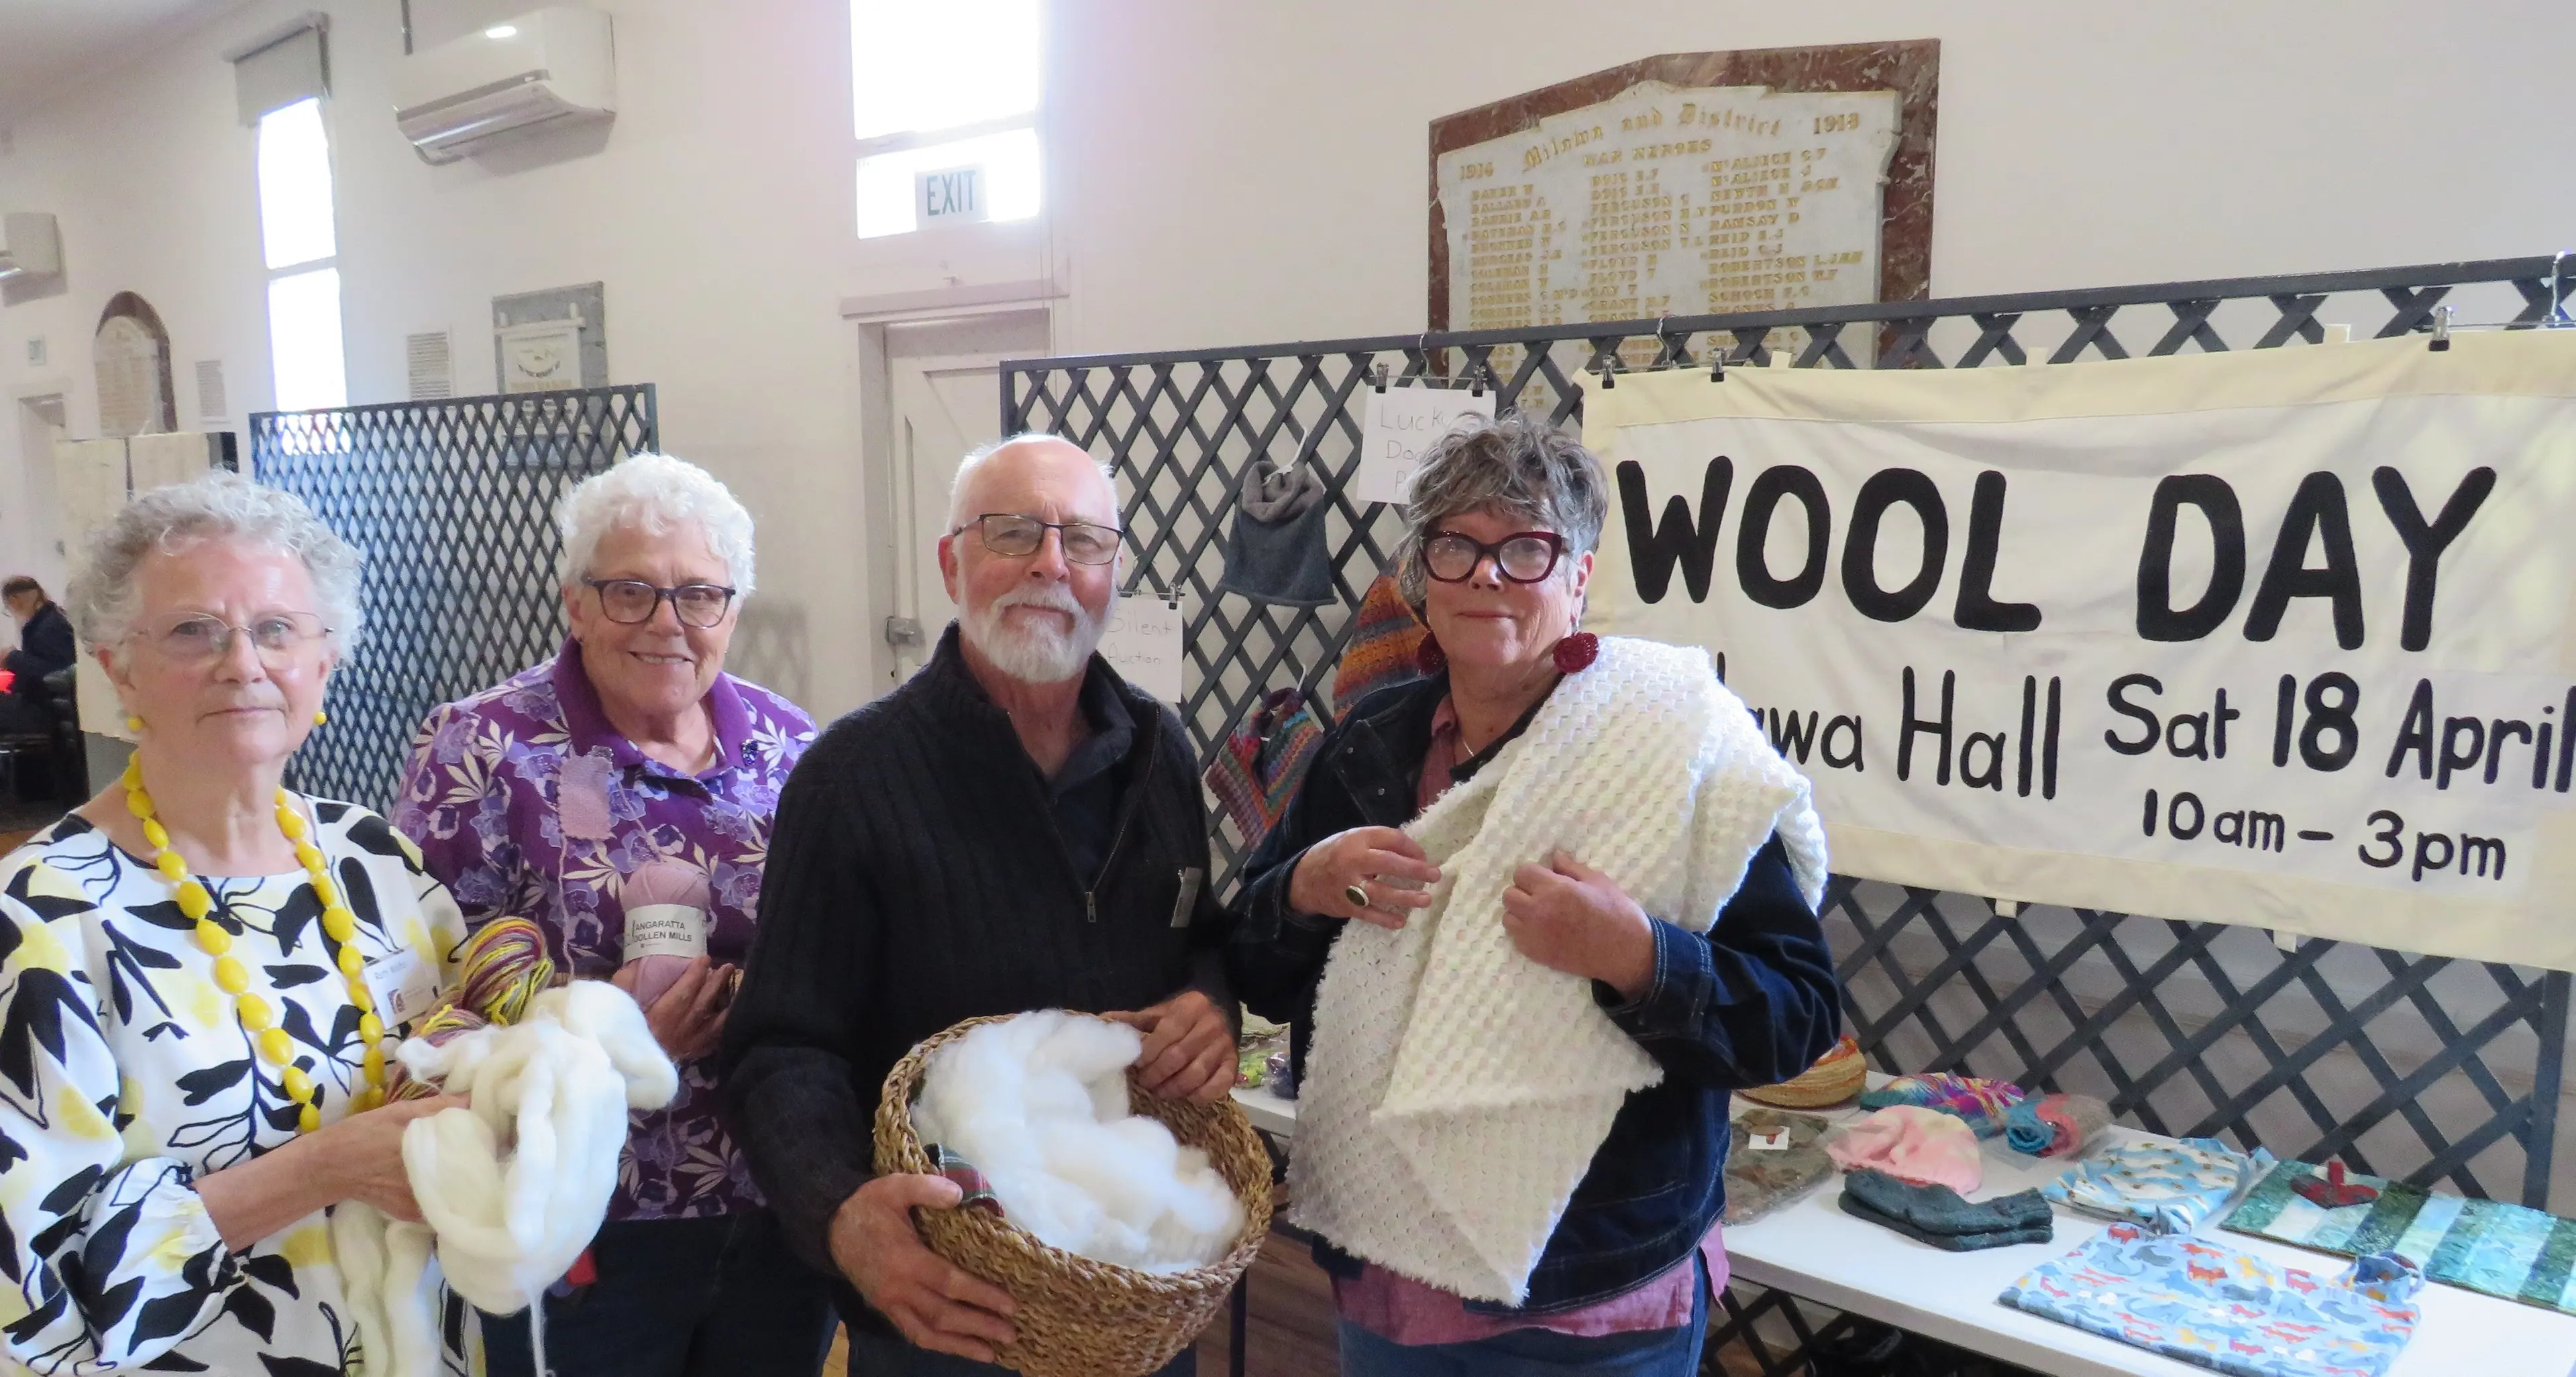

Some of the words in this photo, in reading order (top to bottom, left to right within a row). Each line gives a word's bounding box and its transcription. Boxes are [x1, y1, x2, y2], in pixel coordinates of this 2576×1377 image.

[1621, 107, 1662, 131] and
[1679, 102, 1782, 136] District
[1632, 138, 1711, 161] HEROES
[926, 169, 976, 216] EXIT
[1617, 456, 2041, 632] WOOL
[2137, 465, 2496, 652] DAY
[1108, 608, 1172, 635] Silent
[1898, 666, 2061, 800] Hall
[2105, 674, 2241, 761] Sat
[2273, 672, 2360, 772] 18
[2386, 679, 2576, 793] April
[669, 932, 692, 942] MILLS
